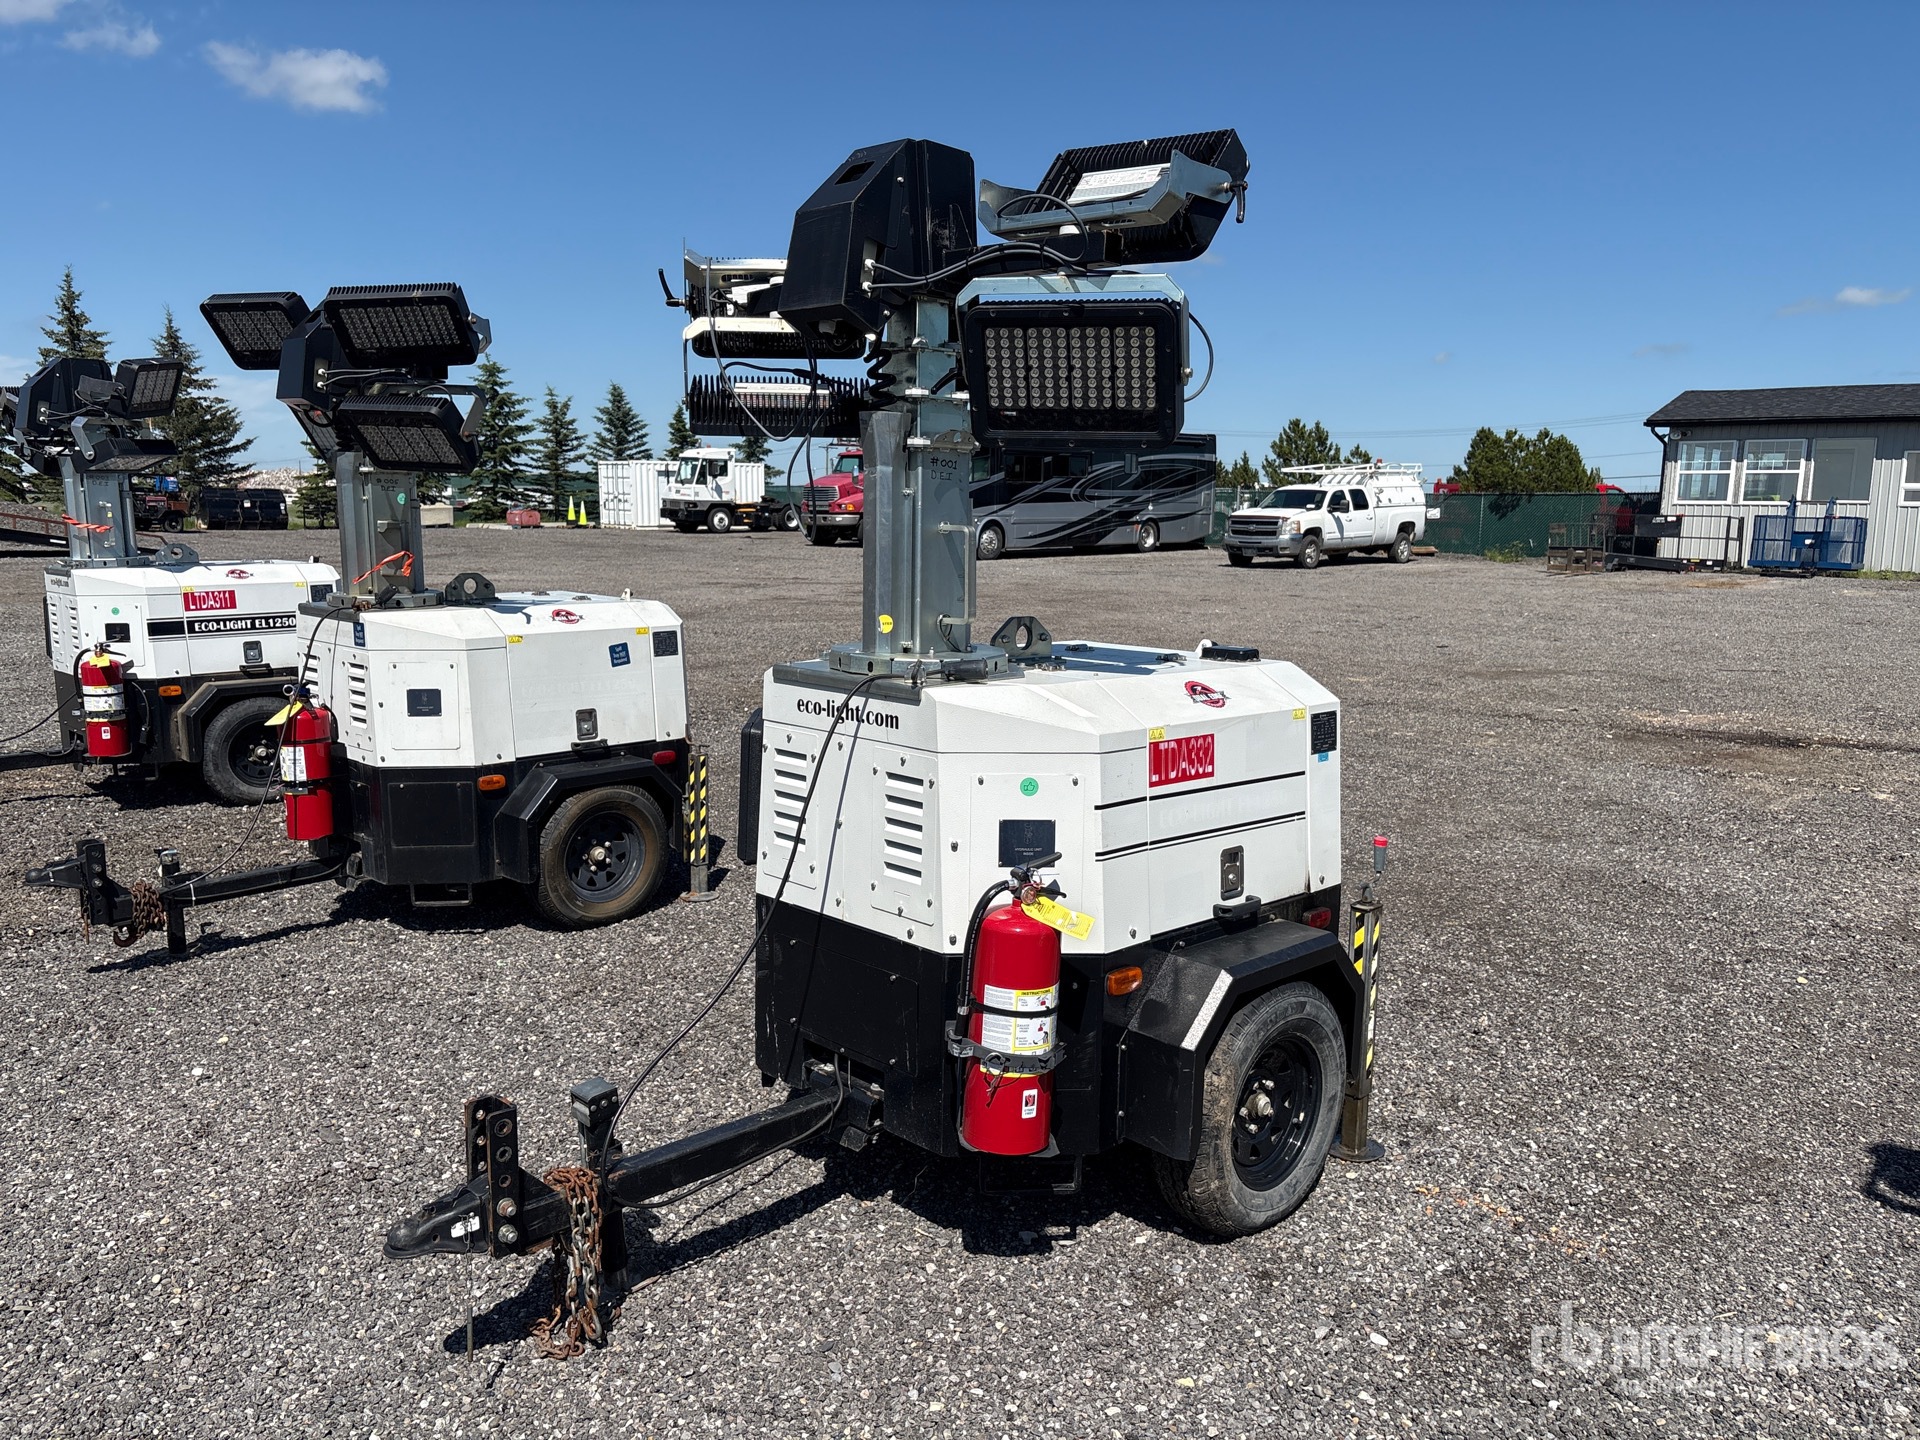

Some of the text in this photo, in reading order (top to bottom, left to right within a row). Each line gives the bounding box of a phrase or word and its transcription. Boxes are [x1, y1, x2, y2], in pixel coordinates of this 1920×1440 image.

[188, 590, 231, 610] LTDA311
[194, 617, 296, 632] ECO-LIGHT EL1250
[796, 698, 899, 730] eco-light.com
[1150, 735, 1214, 784] LTDA332
